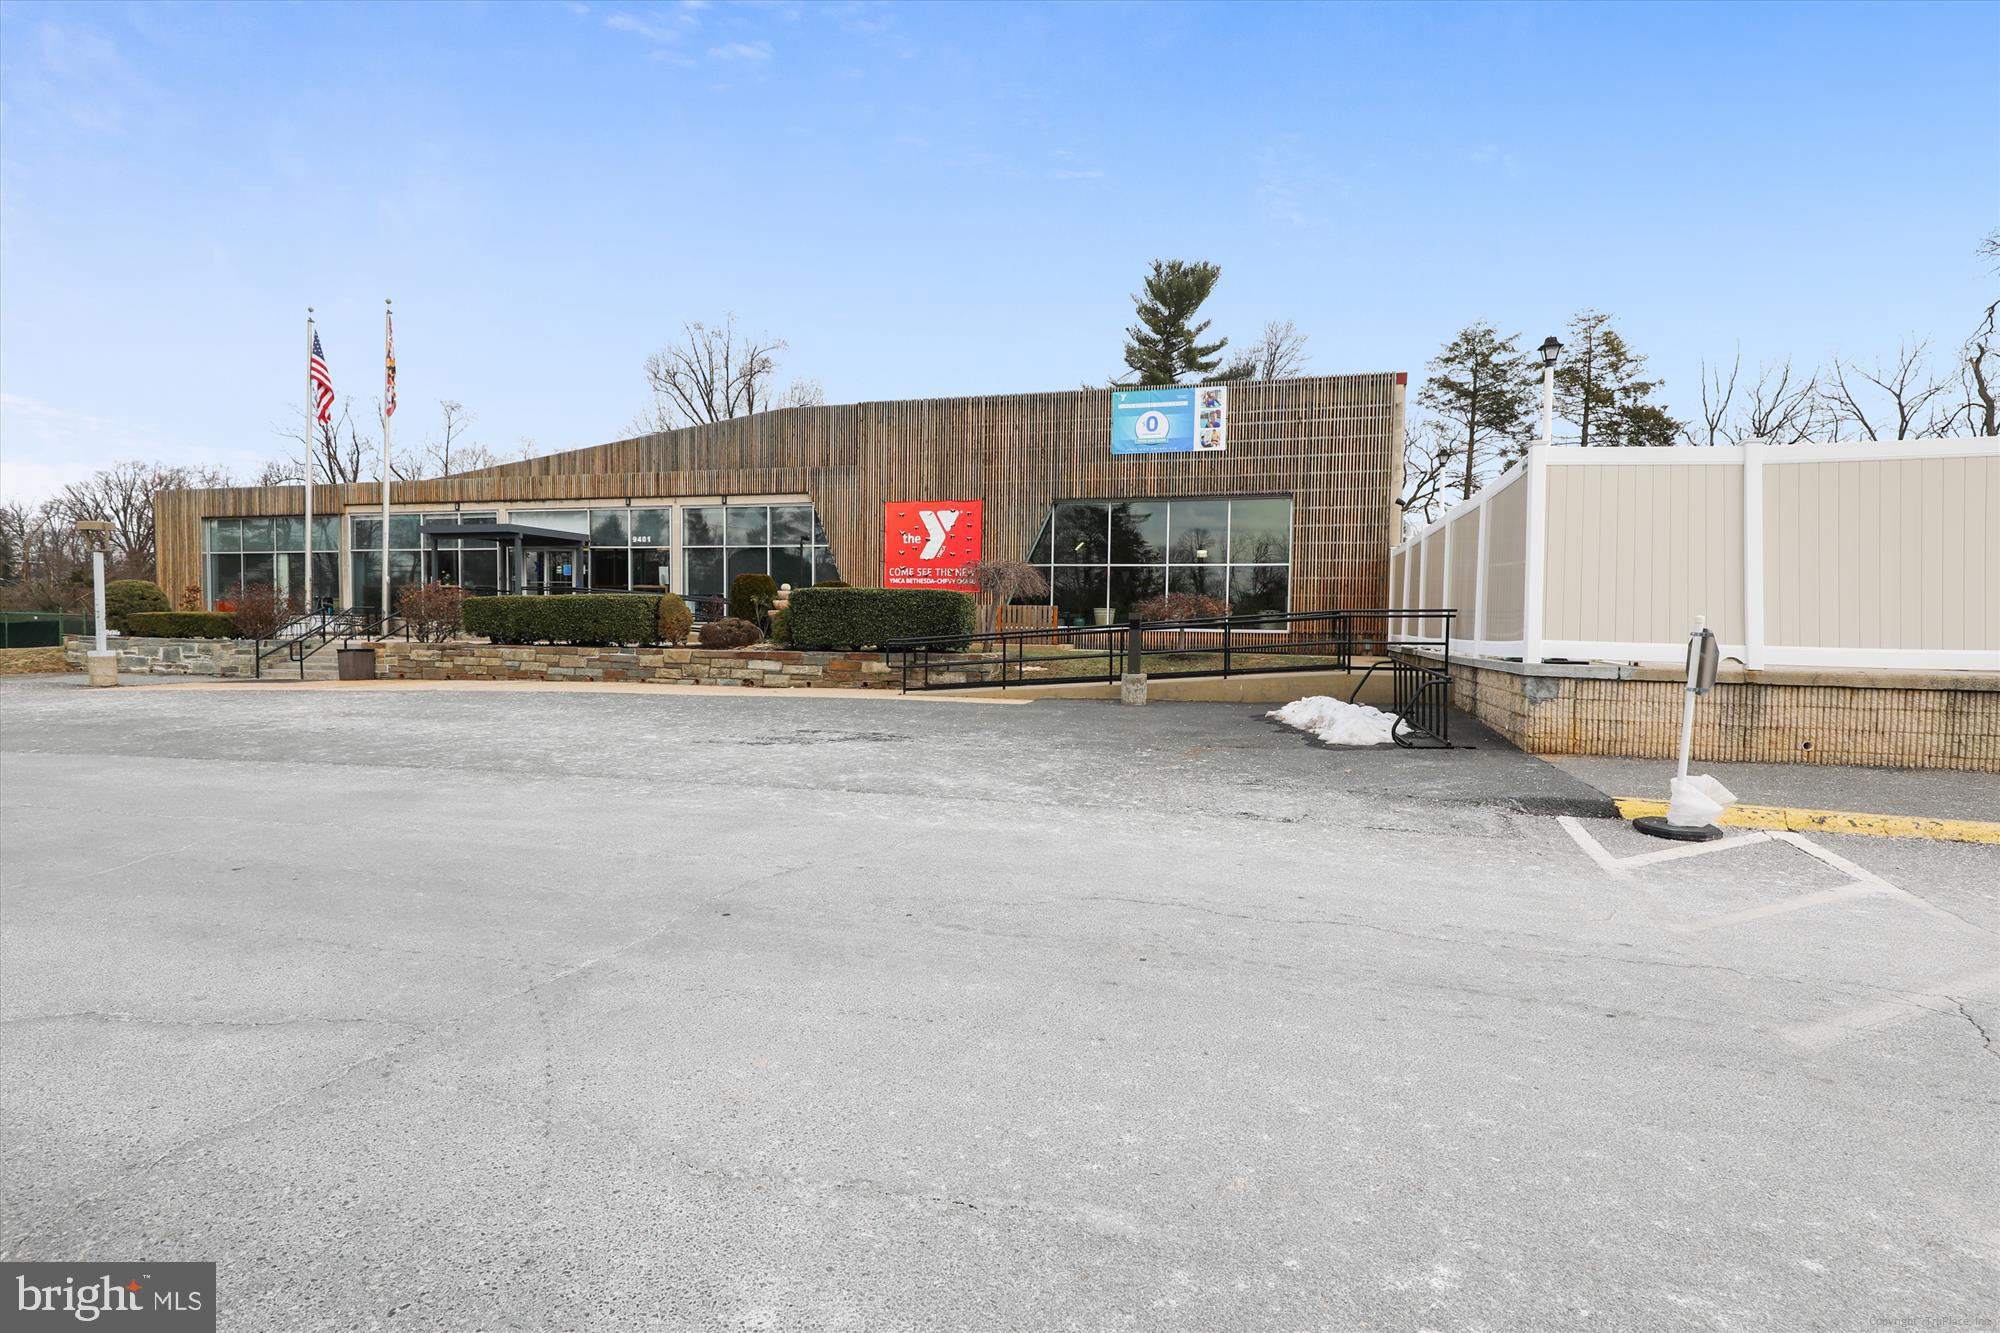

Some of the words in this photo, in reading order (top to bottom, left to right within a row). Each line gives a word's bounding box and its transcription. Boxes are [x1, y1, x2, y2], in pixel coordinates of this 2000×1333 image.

[903, 533, 921, 544] the
[889, 567, 914, 577] COME
[917, 567, 932, 577] SEE
[935, 567, 953, 577] THE
